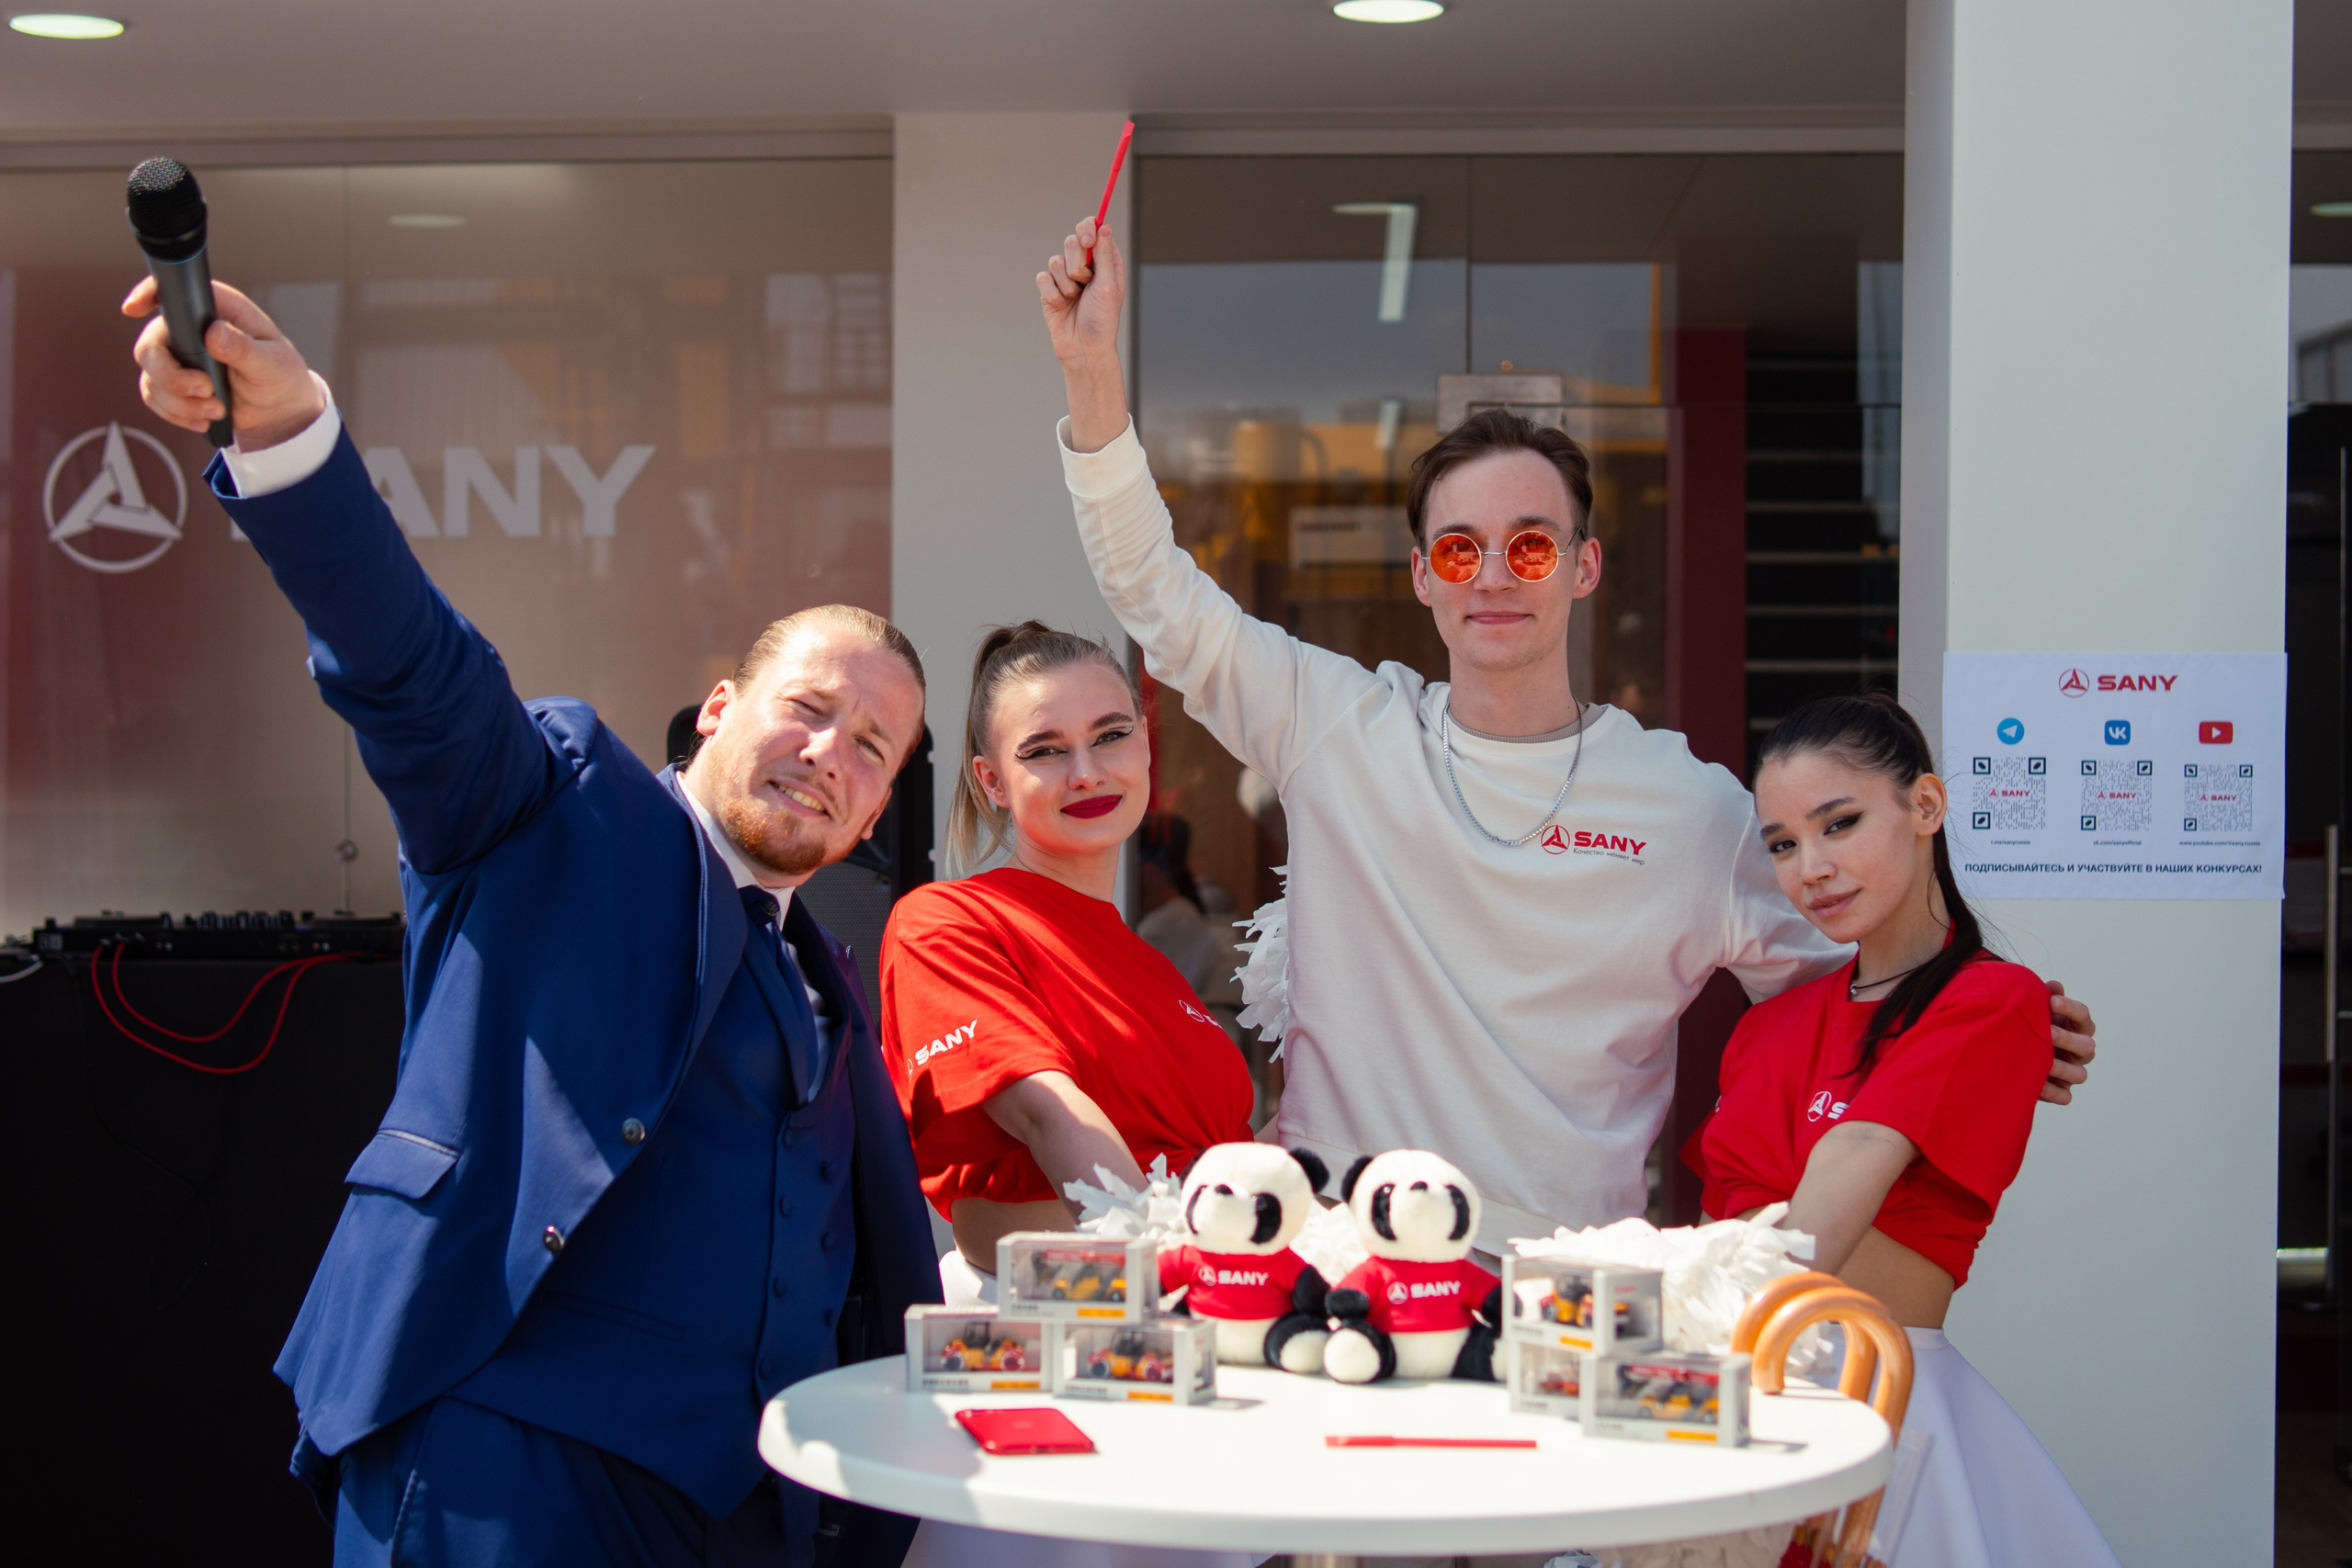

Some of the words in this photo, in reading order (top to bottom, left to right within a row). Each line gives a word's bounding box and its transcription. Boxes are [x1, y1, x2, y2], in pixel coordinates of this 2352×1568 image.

[232, 445, 656, 540] ANY
[2098, 674, 2178, 692] SANY
[2001, 789, 2030, 797] SANY
[1574, 830, 1647, 855] SANY
[1573, 847, 1605, 856] Качество
[1606, 852, 1630, 861] меняет
[1631, 857, 1645, 865] мир
[1964, 863, 2065, 874] ПОДПИСЫВАЙТЕСЬ
[2067, 863, 2075, 873] И
[2077, 863, 2143, 874] УЧАСТВУЙТЕ
[2145, 863, 2153, 874] В
[2155, 864, 2194, 874] НАШИХ
[2196, 864, 2262, 874] КОНКУРСАХ!
[914, 1019, 978, 1066] SANY
[1217, 1269, 1270, 1286] SANY
[1410, 1280, 1462, 1299] SANY
